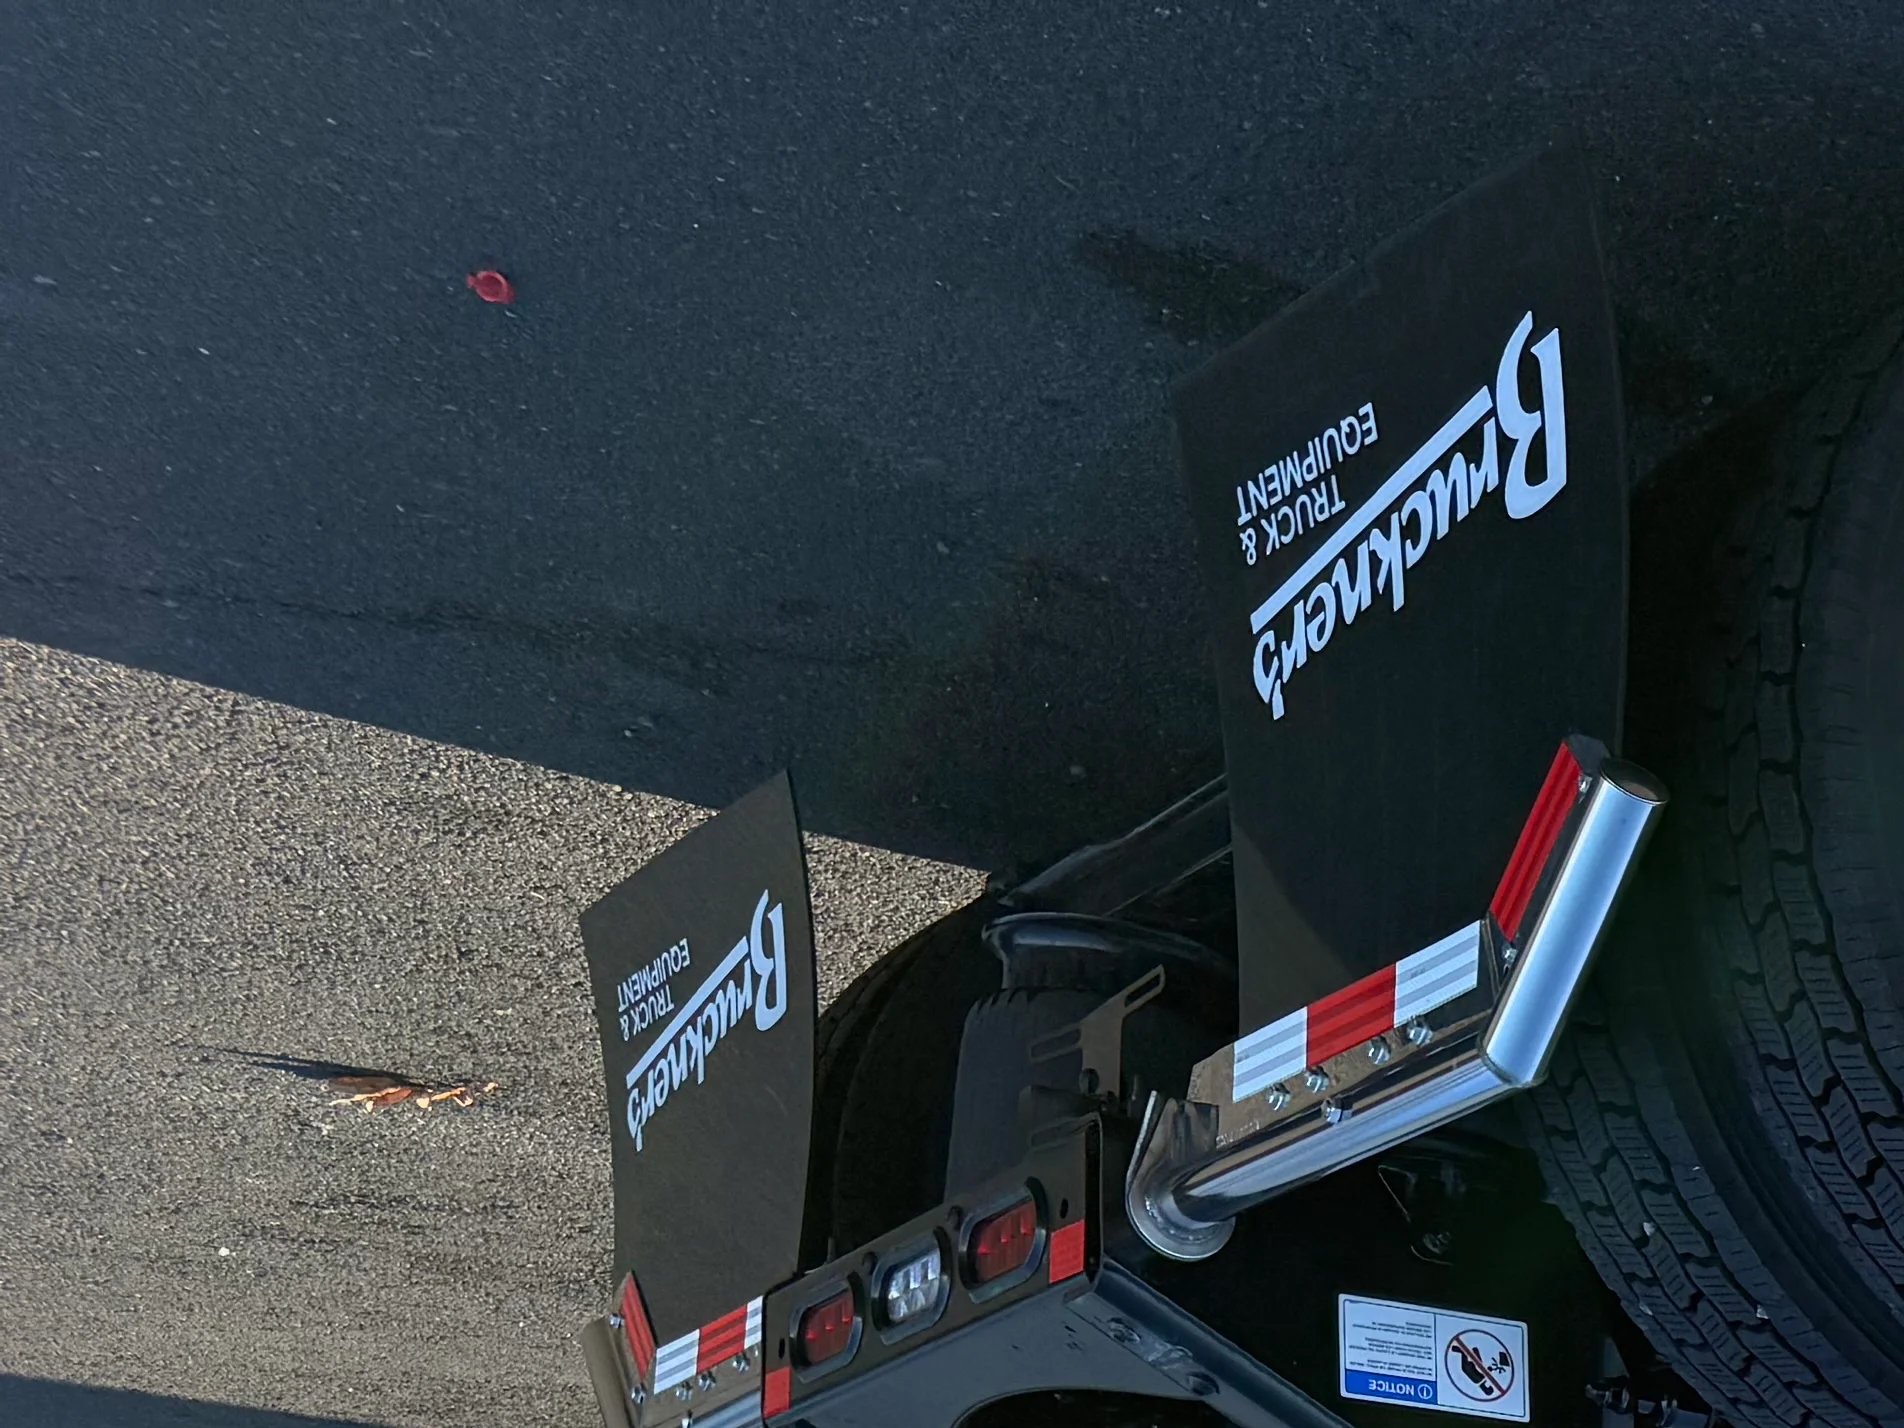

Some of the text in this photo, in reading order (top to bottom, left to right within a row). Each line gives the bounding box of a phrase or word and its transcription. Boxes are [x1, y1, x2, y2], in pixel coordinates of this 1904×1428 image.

[1233, 400, 1378, 526] EQUIPMENT
[1238, 472, 1346, 566] TRUCK &
[1249, 308, 1569, 722] Bruckner's
[615, 936, 690, 1012] EQUIPMENT
[619, 985, 674, 1041] TRUCK &
[625, 888, 789, 1154] Bruckner's
[1367, 1378, 1415, 1397] NOTICE
